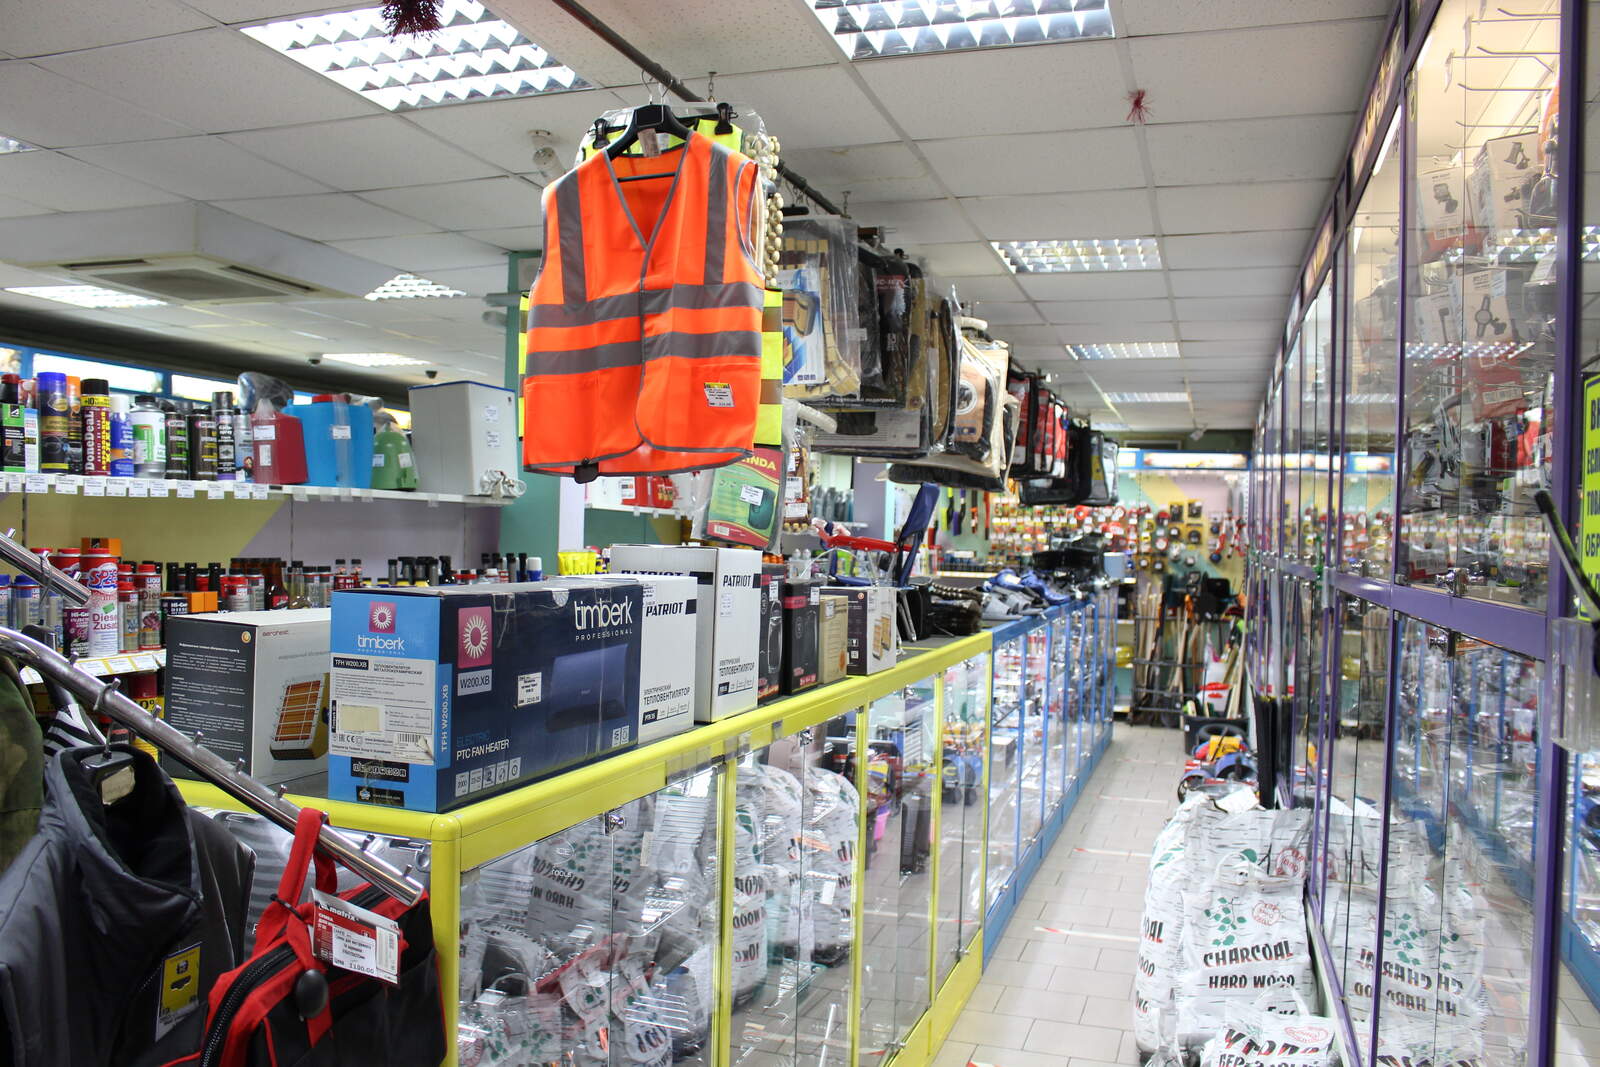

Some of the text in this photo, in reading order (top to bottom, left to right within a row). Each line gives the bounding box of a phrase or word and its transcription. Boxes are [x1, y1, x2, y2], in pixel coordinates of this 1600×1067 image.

[722, 574, 751, 587] PATRIOT
[574, 595, 633, 630] timberk
[646, 602, 684, 617] PATRIOT
[357, 634, 405, 651] timberk
[575, 629, 633, 641] PROFESSIONAL
[460, 675, 490, 689] W200.XB
[643, 687, 690, 706] ТЕПЛОВЕНТИЛЯТОР
[456, 738, 510, 761] PTC FAN HEATER
[329, 906, 356, 922] matrix
[1203, 940, 1294, 968] CHARCOAL
[1208, 974, 1248, 989] HARD
